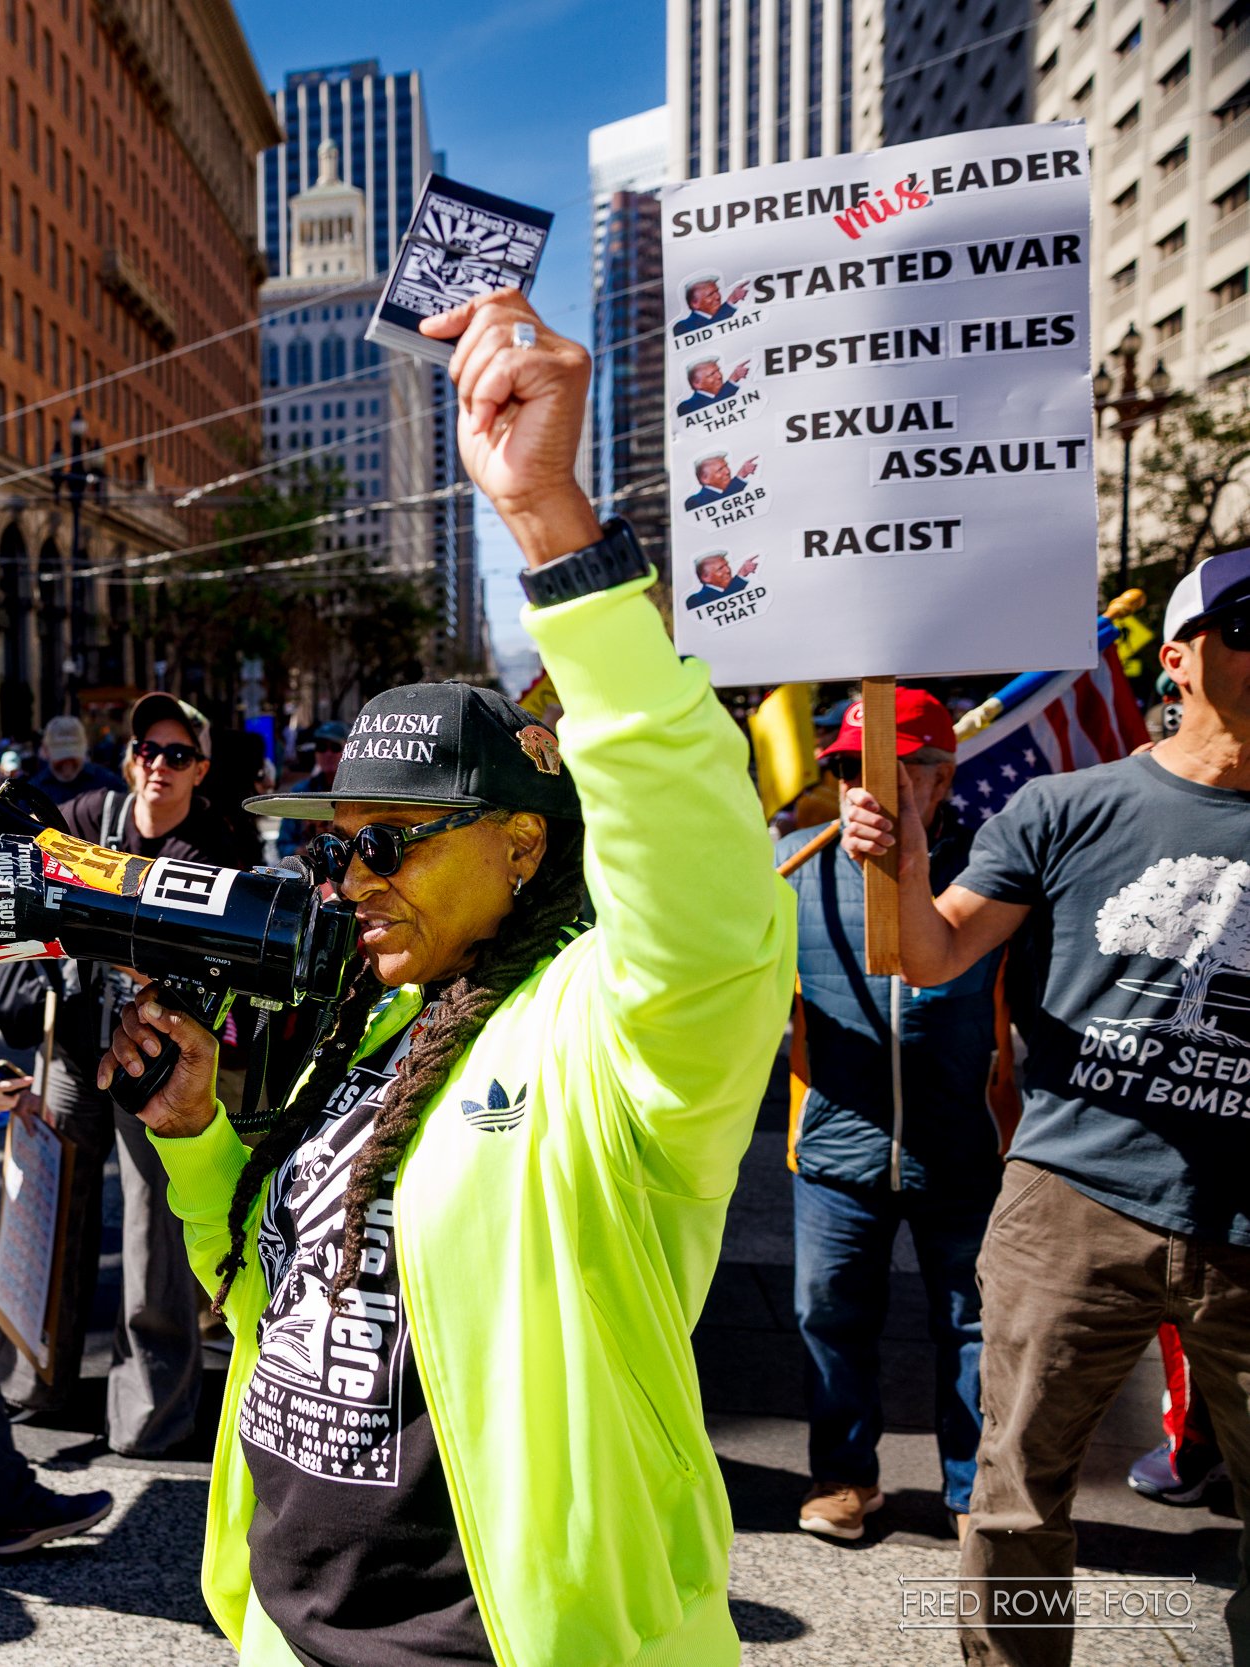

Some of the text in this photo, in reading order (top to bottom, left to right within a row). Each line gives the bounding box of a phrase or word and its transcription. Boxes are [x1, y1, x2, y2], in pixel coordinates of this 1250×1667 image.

[672, 182, 870, 238] SUPREME
[833, 177, 932, 240] mis
[753, 234, 1081, 304] STARTED WAR
[684, 327, 713, 347] DID
[716, 309, 762, 336] THAT
[764, 314, 1076, 377] EPSTEIN FILES
[684, 389, 761, 428] ALL UP IN
[703, 407, 748, 434] THAT
[786, 400, 954, 443] SEXUAL
[879, 438, 1086, 481] ASSAULT
[694, 486, 767, 521] I'D GRAB
[711, 503, 756, 529] THAT
[803, 519, 961, 559] RACIST
[707, 586, 768, 616] POSTED
[713, 602, 758, 628] THAT
[356, 713, 442, 736] RACISM
[359, 738, 437, 764] AGAIN
[204, 956, 231, 966] AUX/MP3
[1079, 1025, 1164, 1066] DROP
[1068, 1061, 1144, 1097] NOT
[257, 1399, 282, 1424] DANCE
[286, 1413, 320, 1438] STAGE
[327, 1426, 373, 1446] NOON
[290, 1394, 338, 1423] MARCH
[342, 1409, 390, 1428] 10AM
[258, 1415, 285, 1438] PLAZA
[302, 1435, 360, 1461] MARKET
[370, 1447, 390, 1463] ST
[298, 1447, 323, 1472] 2026
